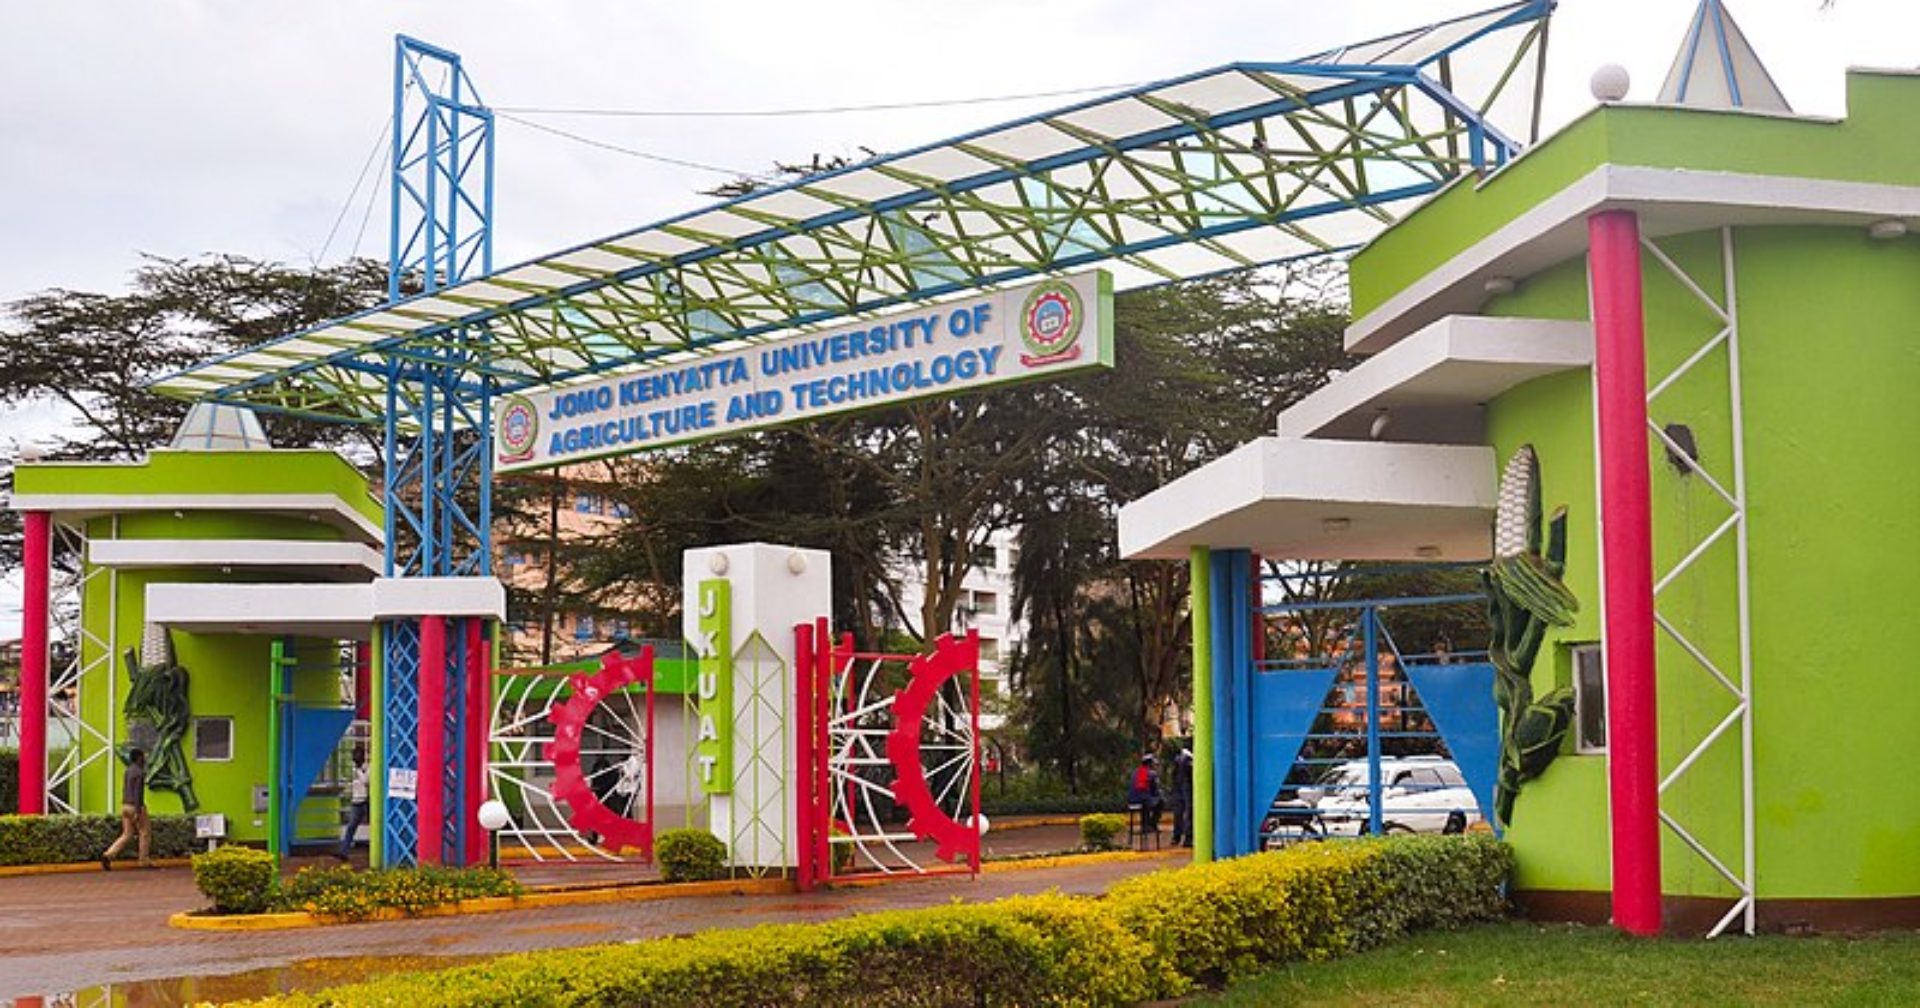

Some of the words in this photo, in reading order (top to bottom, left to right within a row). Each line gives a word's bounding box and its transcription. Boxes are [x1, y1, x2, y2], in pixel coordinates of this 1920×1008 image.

[548, 401, 717, 456] AGRICULTURE
[726, 388, 783, 423] AND
[791, 345, 1003, 409] TECHNOLOGY
[549, 385, 613, 420] JOMO
[619, 356, 749, 405] KENYATTA
[762, 314, 938, 377] UNIVERSITY
[948, 304, 991, 338] OF
[697, 588, 718, 784] JKUAT
